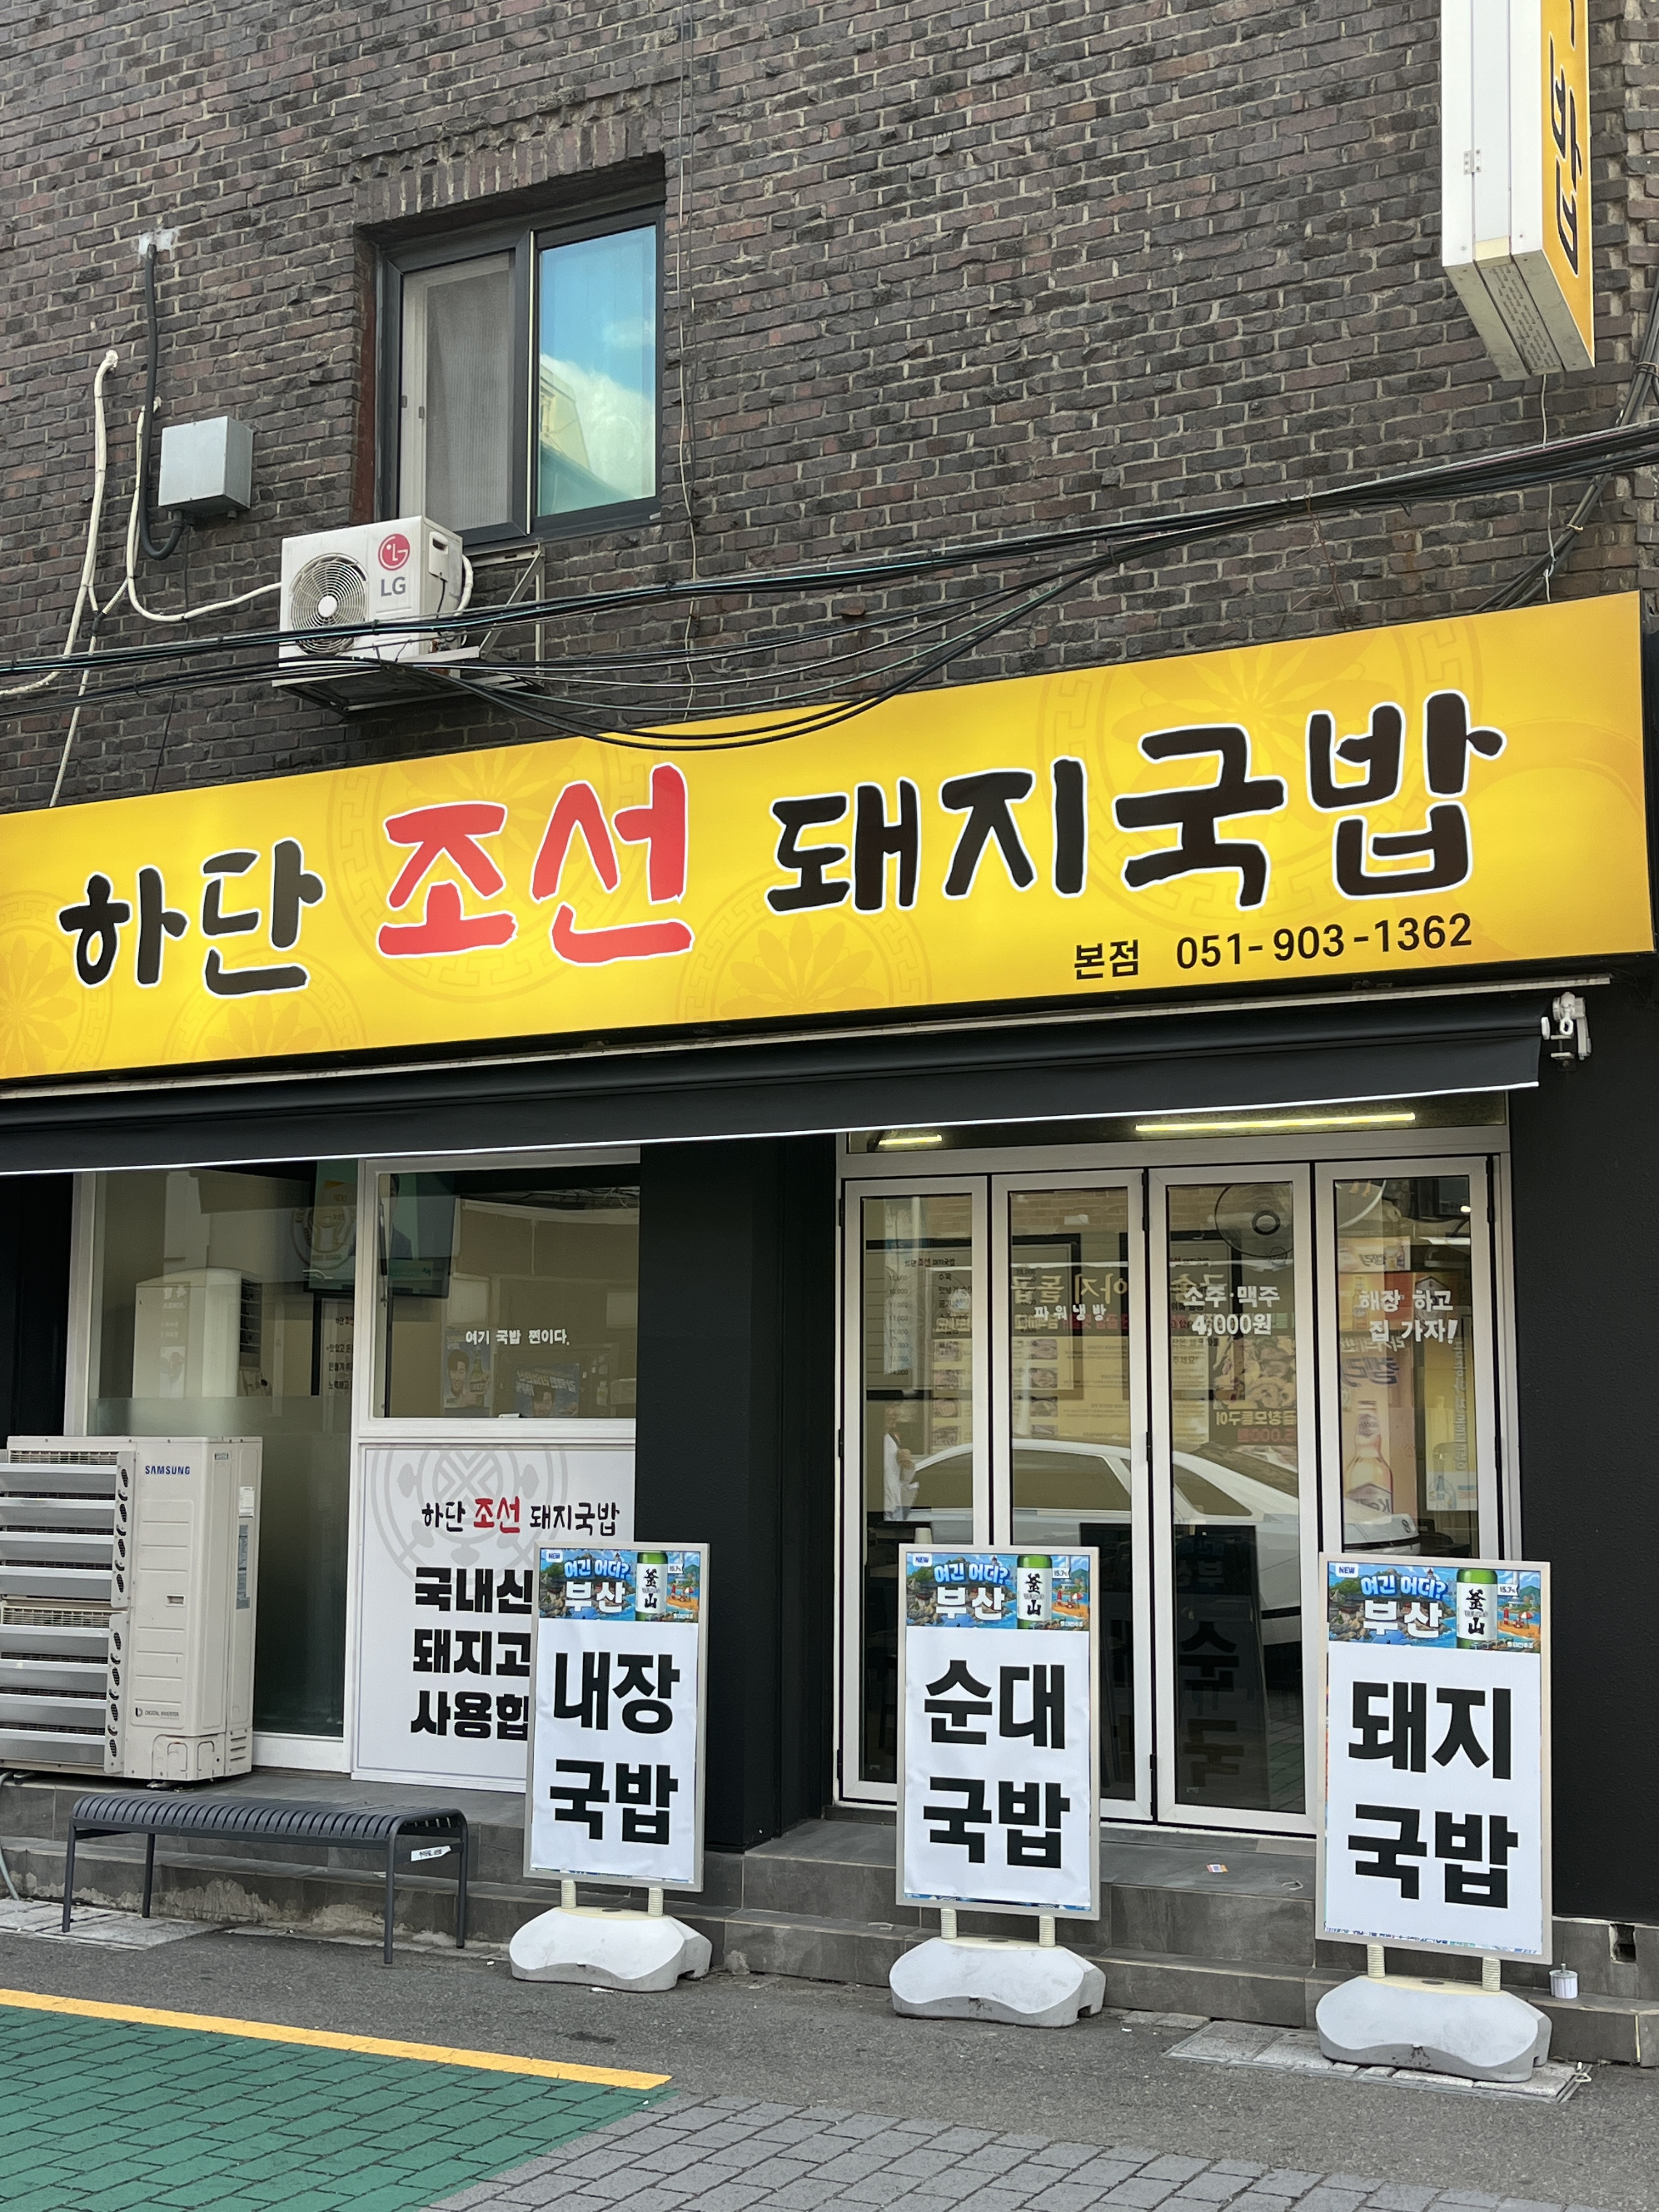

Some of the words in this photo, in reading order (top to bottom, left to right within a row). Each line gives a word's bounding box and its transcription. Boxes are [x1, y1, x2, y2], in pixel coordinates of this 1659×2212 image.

[1548, 0, 1583, 278] 밥
[380, 575, 406, 598] LG
[58, 839, 323, 996] 하단
[378, 765, 692, 964] 조선
[769, 691, 1503, 913] 돼지국밥
[1074, 939, 1139, 980] 본점
[1359, 1289, 1401, 1312] 해장
[1412, 1289, 1453, 1312] 하고
[466, 1330, 489, 1345] 여기
[496, 1329, 521, 1345] 국밥
[1192, 1313, 1272, 1336] 4,000원
[1369, 1319, 1390, 1342] 집
[1401, 1318, 1458, 1345] 가자!
[145, 1465, 190, 1475] SAMSUNG
[421, 1500, 466, 1533] 하단
[473, 1496, 521, 1534] 조선
[529, 1502, 620, 1537] 돼지국밥
[565, 1559, 592, 1578] 여긴
[595, 1559, 630, 1579] 어디?
[934, 1563, 965, 1583] 여긴
[969, 1562, 1009, 1585] 어디?
[1338, 1566, 1356, 1575] NEW
[1361, 1575, 1396, 1597] 여긴
[1400, 1576, 1448, 1600] 어디?
[565, 1581, 626, 1613] 부산
[935, 1585, 1005, 1621] 부산
[1363, 1600, 1442, 1639] 부산
[413, 1628, 531, 1677] 돼지고
[553, 1651, 681, 1735] 내장
[924, 1659, 1066, 1750] 순대
[410, 1690, 528, 1741] 사용합
[1348, 1680, 1512, 1781] 돼지
[549, 1758, 679, 1846] 국밥
[923, 1775, 1071, 1870] 국밥
[1347, 1803, 1519, 1910] 국밥
